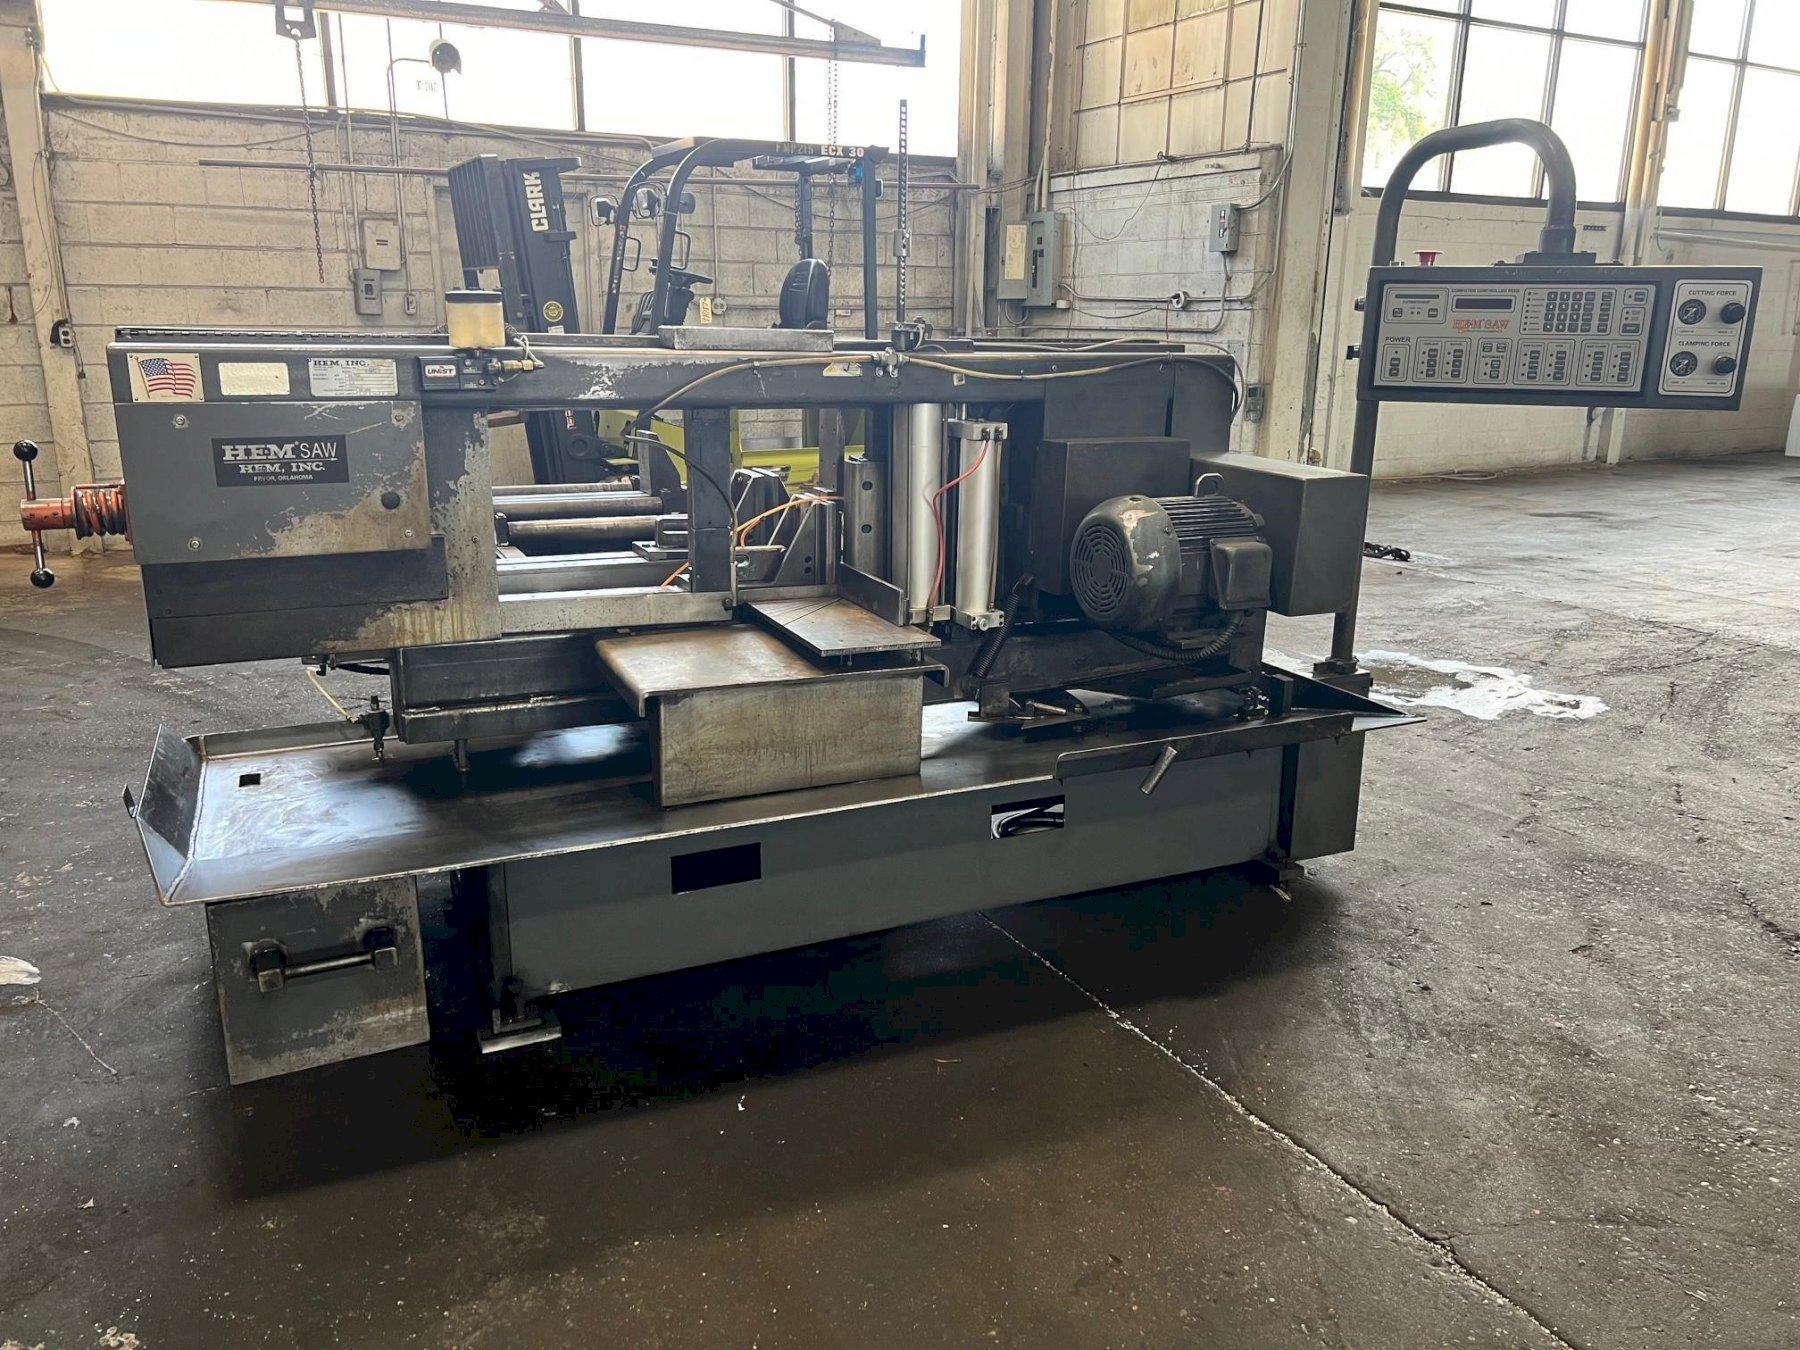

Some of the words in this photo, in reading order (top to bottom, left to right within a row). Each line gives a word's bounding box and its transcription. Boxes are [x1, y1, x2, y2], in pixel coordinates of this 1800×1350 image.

[821, 145, 844, 157] ECX
[848, 147, 865, 158] 30
[523, 171, 549, 232] CLARK
[222, 443, 296, 460] HEM
[300, 442, 337, 459] SAW
[291, 461, 326, 472] INC.
